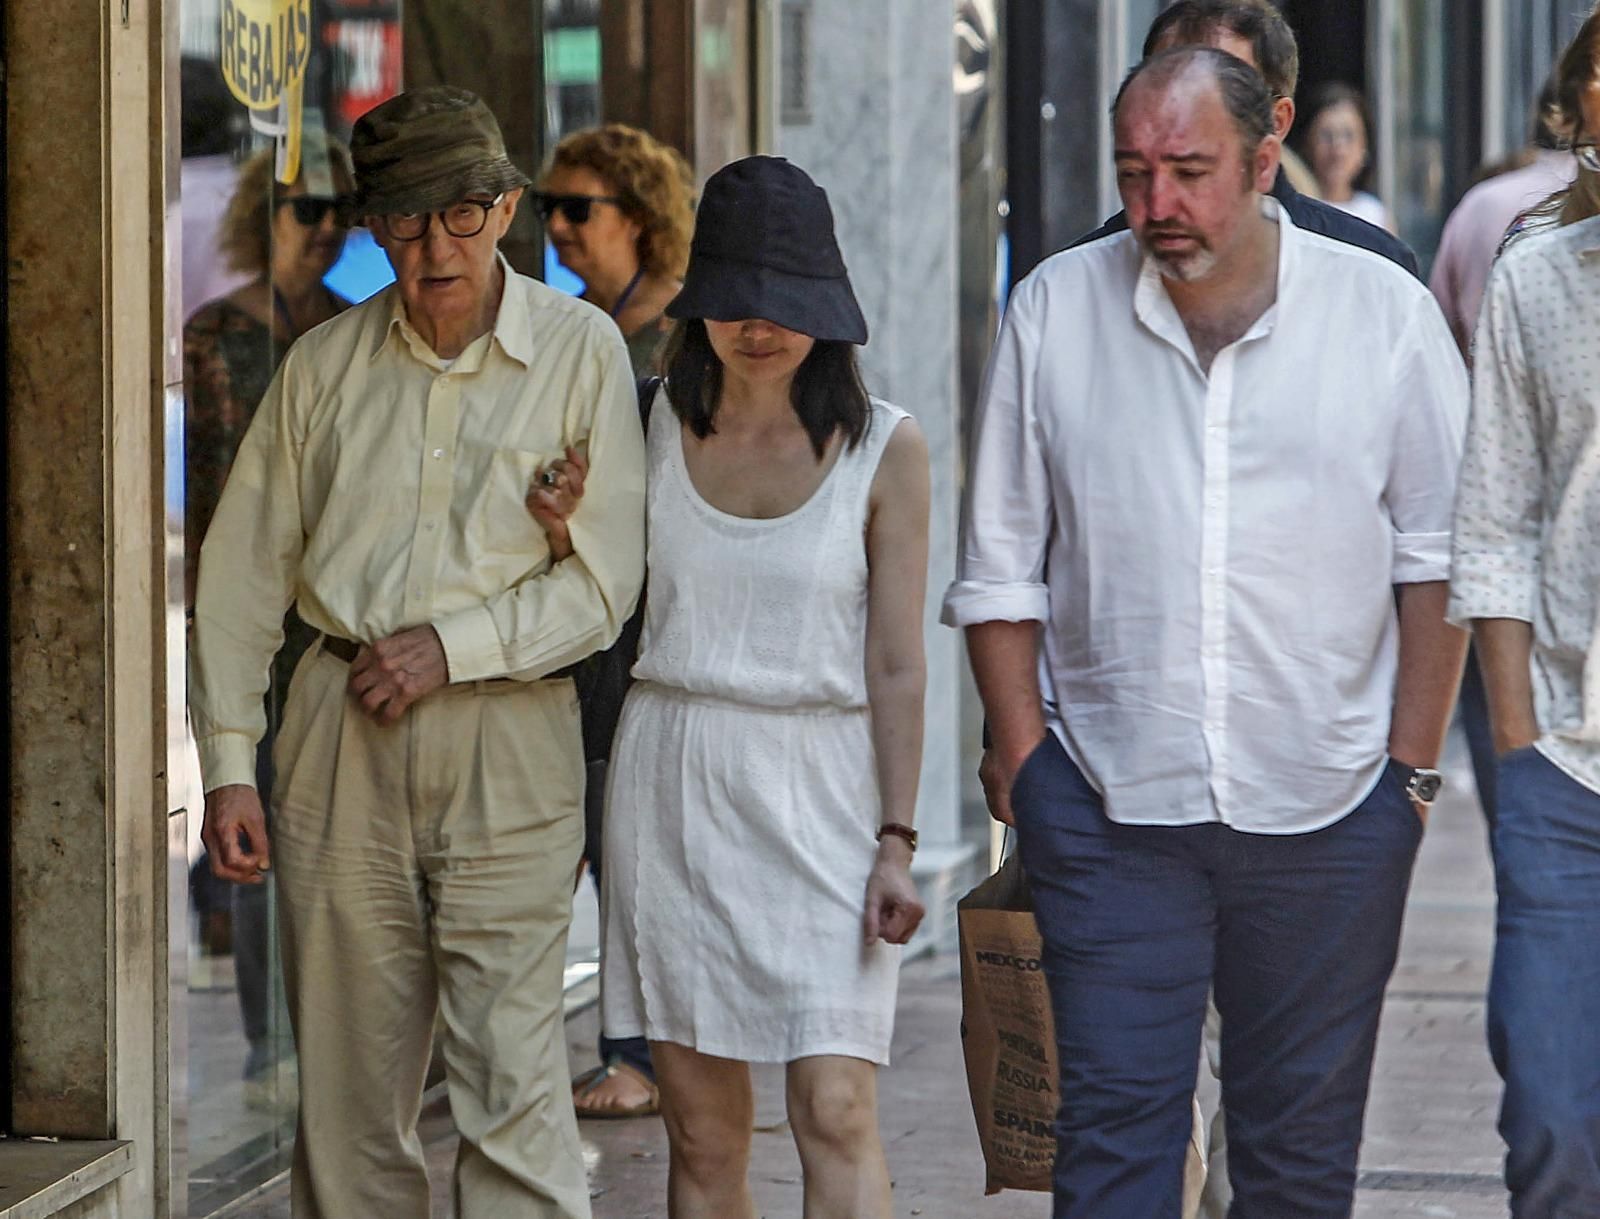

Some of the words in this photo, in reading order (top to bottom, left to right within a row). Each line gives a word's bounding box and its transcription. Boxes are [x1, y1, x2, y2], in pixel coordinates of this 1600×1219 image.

[224, 0, 307, 102] REBAJAS
[975, 951, 1041, 971] MEXICO
[996, 1060, 1052, 1093] RUSSIA
